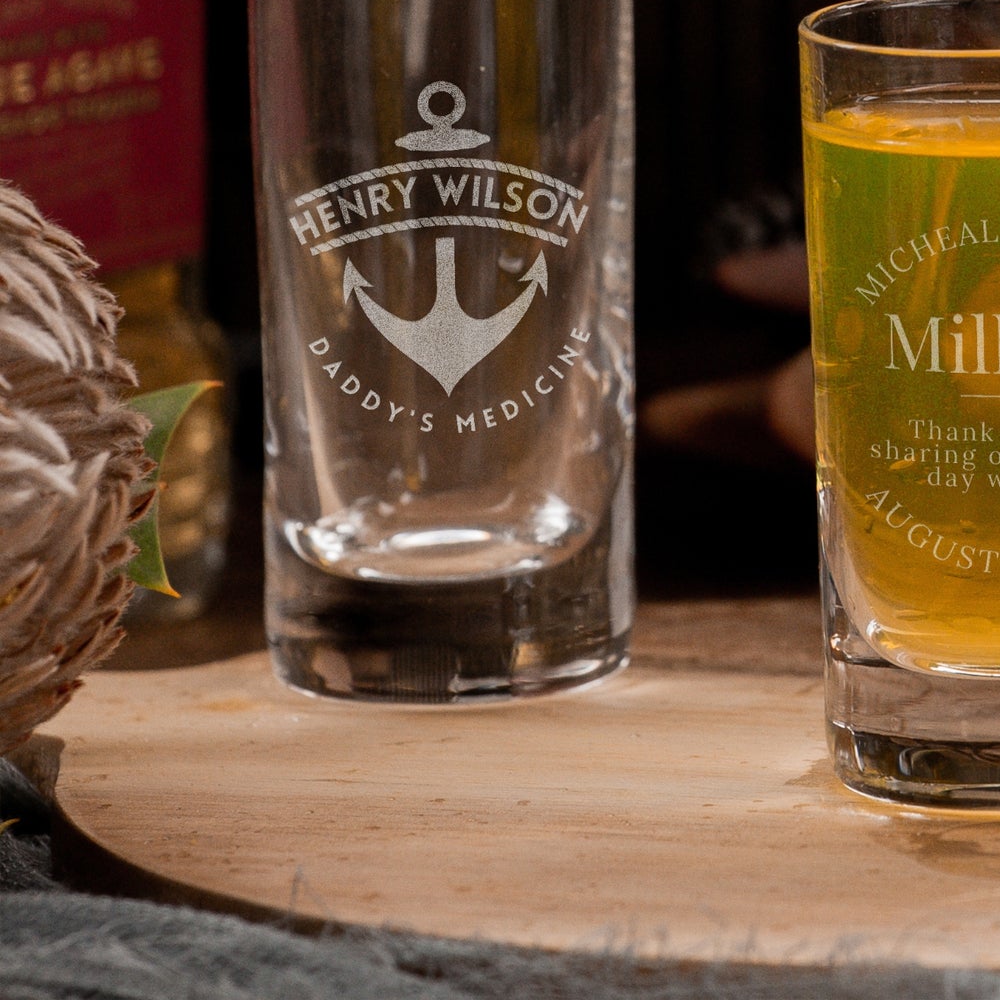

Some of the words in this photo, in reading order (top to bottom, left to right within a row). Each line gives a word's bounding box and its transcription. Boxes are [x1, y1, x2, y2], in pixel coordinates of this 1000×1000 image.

[289, 176, 417, 245] HENRY
[433, 174, 589, 234] WILSON
[854, 219, 999, 305] MICHEAL
[308, 336, 434, 432] DADDY'S
[456, 327, 591, 433] MEDICINE
[870, 440, 977, 470] sharing
[908, 419, 993, 442] Thank
[927, 467, 973, 493] day
[865, 488, 999, 574] AUGUST
